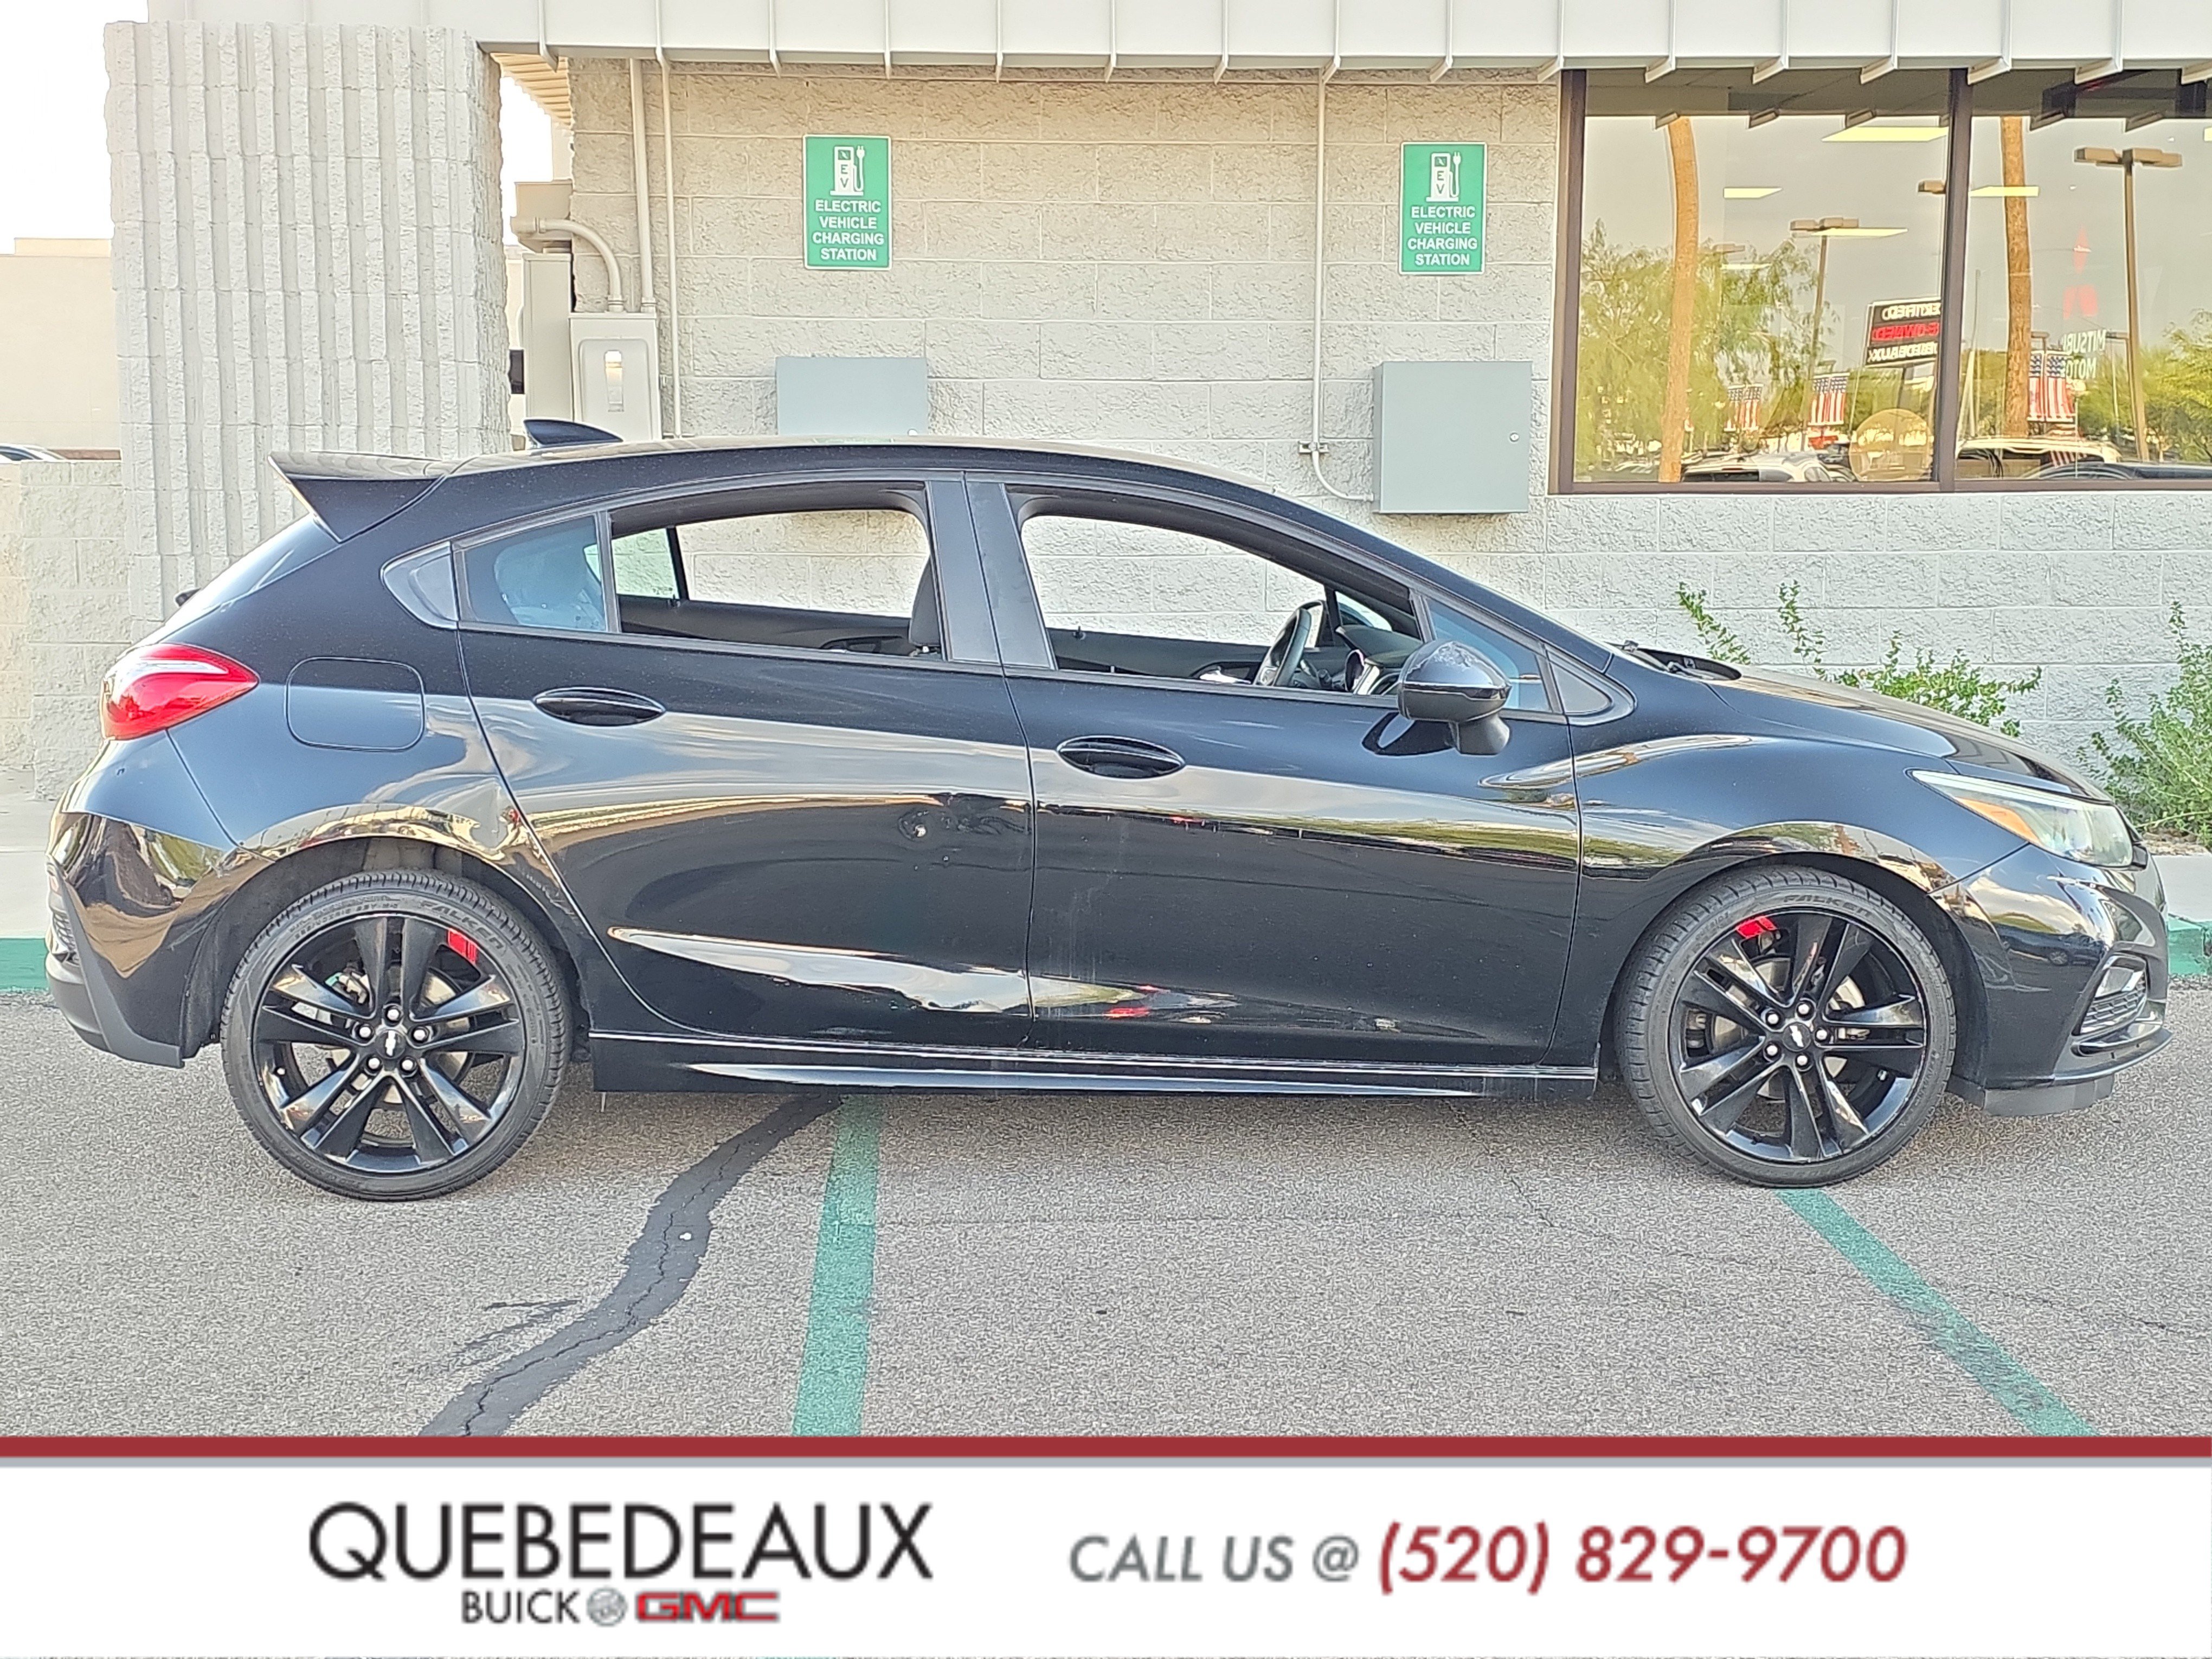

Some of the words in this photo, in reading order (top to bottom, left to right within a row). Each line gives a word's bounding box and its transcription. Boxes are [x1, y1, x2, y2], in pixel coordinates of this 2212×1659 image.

[840, 164, 850, 188] EV
[1436, 170, 1445, 194] EV
[815, 199, 882, 213] ELECTRIC
[1411, 206, 1476, 218] ELECTRIC
[819, 216, 877, 229] VEHICLE
[1414, 222, 1471, 234] VEHICLE
[812, 232, 884, 245] CHARGING
[1407, 237, 1477, 250] CHARGING
[820, 248, 877, 261] STATION
[1414, 253, 1470, 266] STATION
